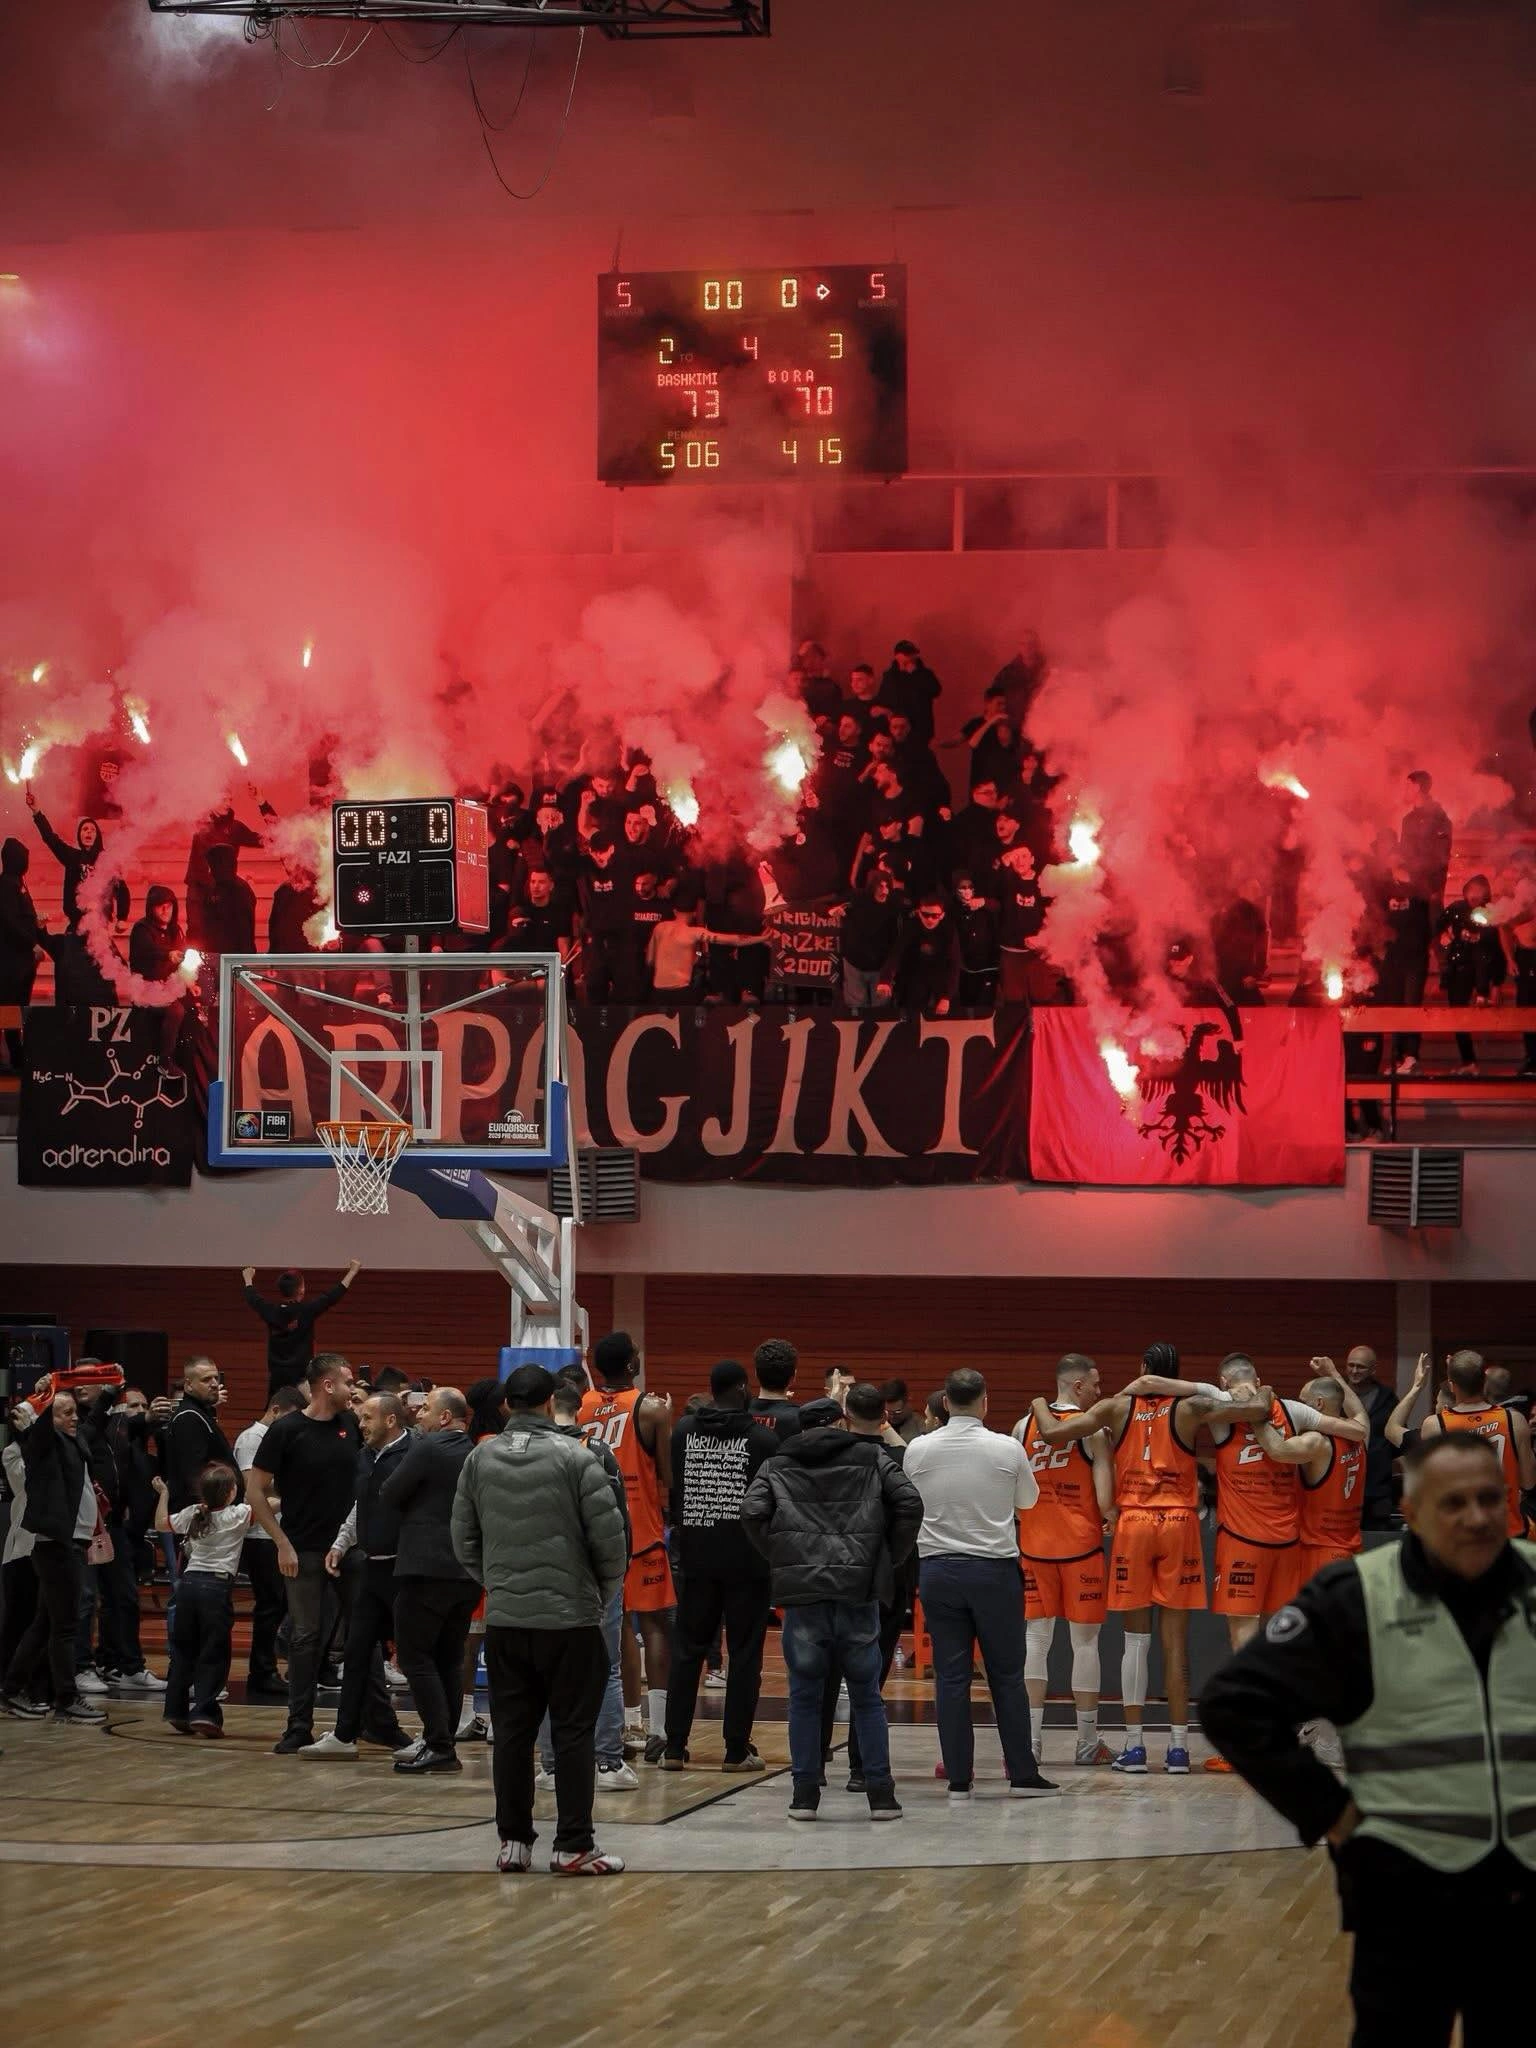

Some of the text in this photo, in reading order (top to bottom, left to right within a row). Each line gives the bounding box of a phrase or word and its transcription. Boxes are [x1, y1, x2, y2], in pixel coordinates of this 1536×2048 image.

[704, 281, 743, 310] 00
[659, 338, 674, 365] 2
[743, 336, 758, 360] 4
[829, 333, 844, 359] 3
[657, 372, 718, 387] BASHKIMI
[768, 369, 815, 384] BORA
[683, 389, 720, 419] 73
[795, 386, 833, 416] 70
[377, 850, 411, 865] FAZI
[467, 851, 478, 867] FAZI
[784, 957, 833, 977] 2000
[88, 1005, 134, 1043] PZ
[266, 1115, 286, 1126] FIBA
[488, 1122, 540, 1133] EUROBASKET
[42, 1134, 171, 1169] adrenalina
